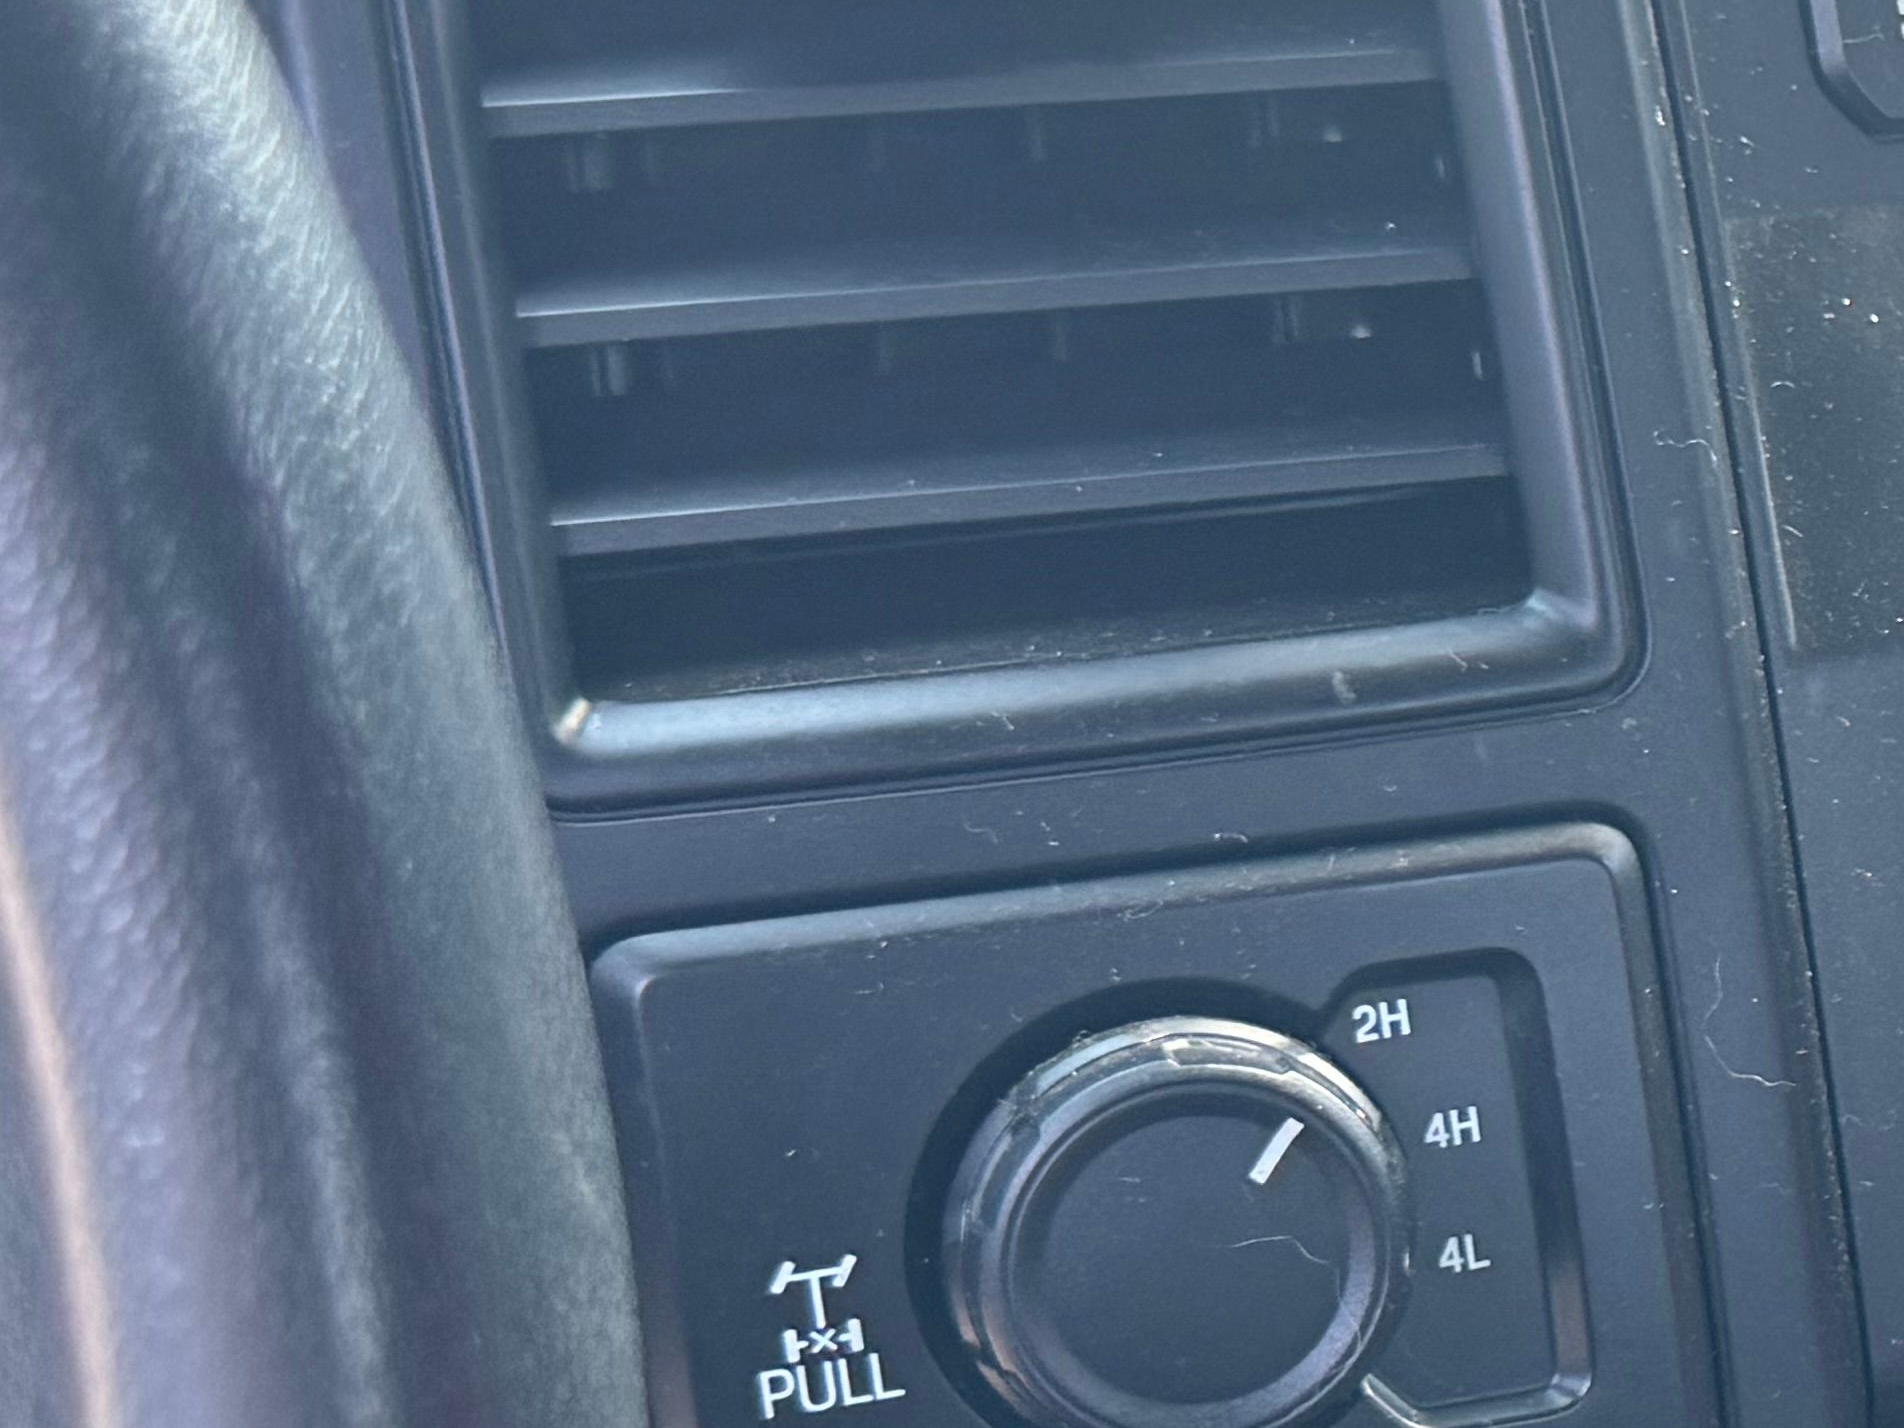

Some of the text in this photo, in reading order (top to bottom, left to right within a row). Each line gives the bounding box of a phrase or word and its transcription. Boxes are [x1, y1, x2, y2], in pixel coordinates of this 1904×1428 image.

[1352, 998, 1412, 1045] 2H
[1423, 1105, 1483, 1149] 4H
[1437, 1233, 1492, 1274] 4L
[756, 1350, 907, 1420] PULL
